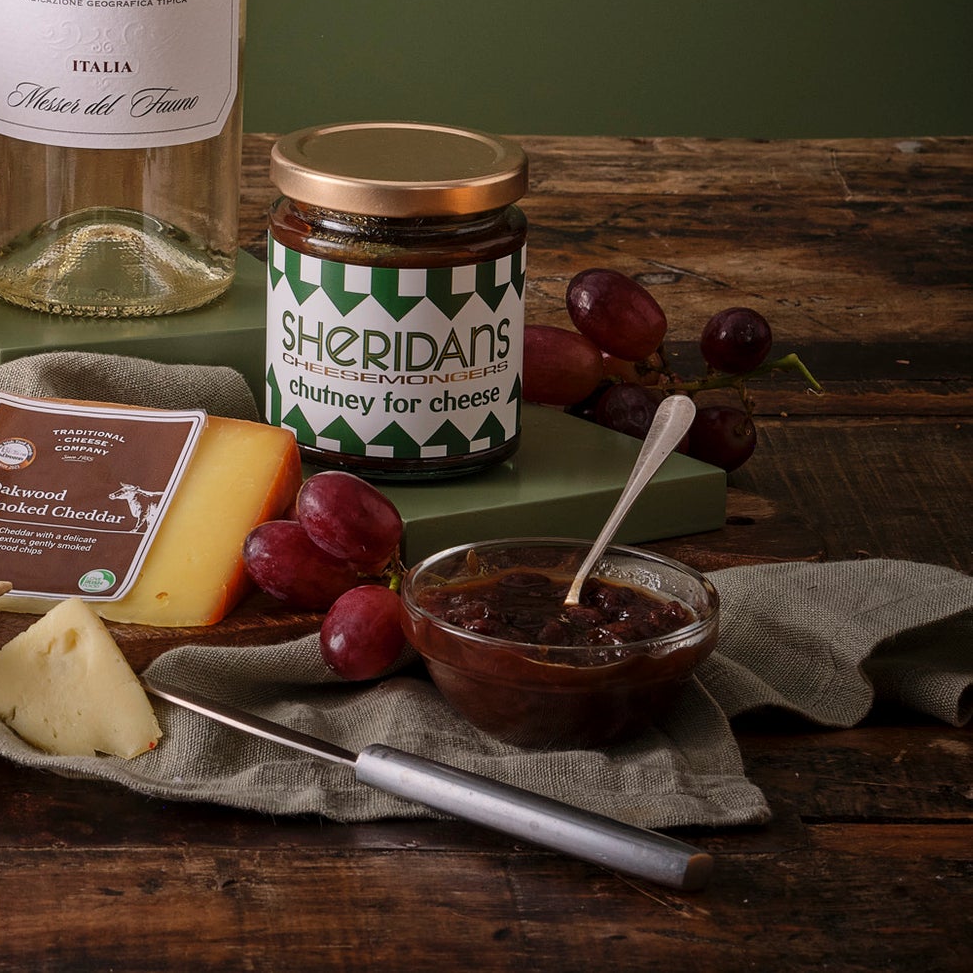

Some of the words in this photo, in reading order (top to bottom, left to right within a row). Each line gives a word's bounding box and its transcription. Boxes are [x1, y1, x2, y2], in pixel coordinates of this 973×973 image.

[87, 0, 153, 8] GEOGRAFICA
[72, 60, 133, 74] ITALIA
[6, 81, 81, 115] Messer
[84, 93, 126, 117] del
[130, 86, 199, 118] Fauno
[282, 353, 508, 385] CHEESEMONGERS
[289, 376, 376, 416] chutney
[383, 391, 422, 413] for
[429, 386, 500, 413] cheese
[52, 429, 126, 443] TRADITIONAL
[64, 437, 109, 447] CHEESE
[54, 445, 109, 456] COMPANY
[52, 504, 125, 525] Cheddar
[0, 526, 35, 537] Cheddar
[36, 530, 54, 539] with
[62, 534, 97, 544] delicate
[19, 546, 43, 556] chips
[29, 539, 56, 548] gently
[57, 541, 92, 552] smoked
